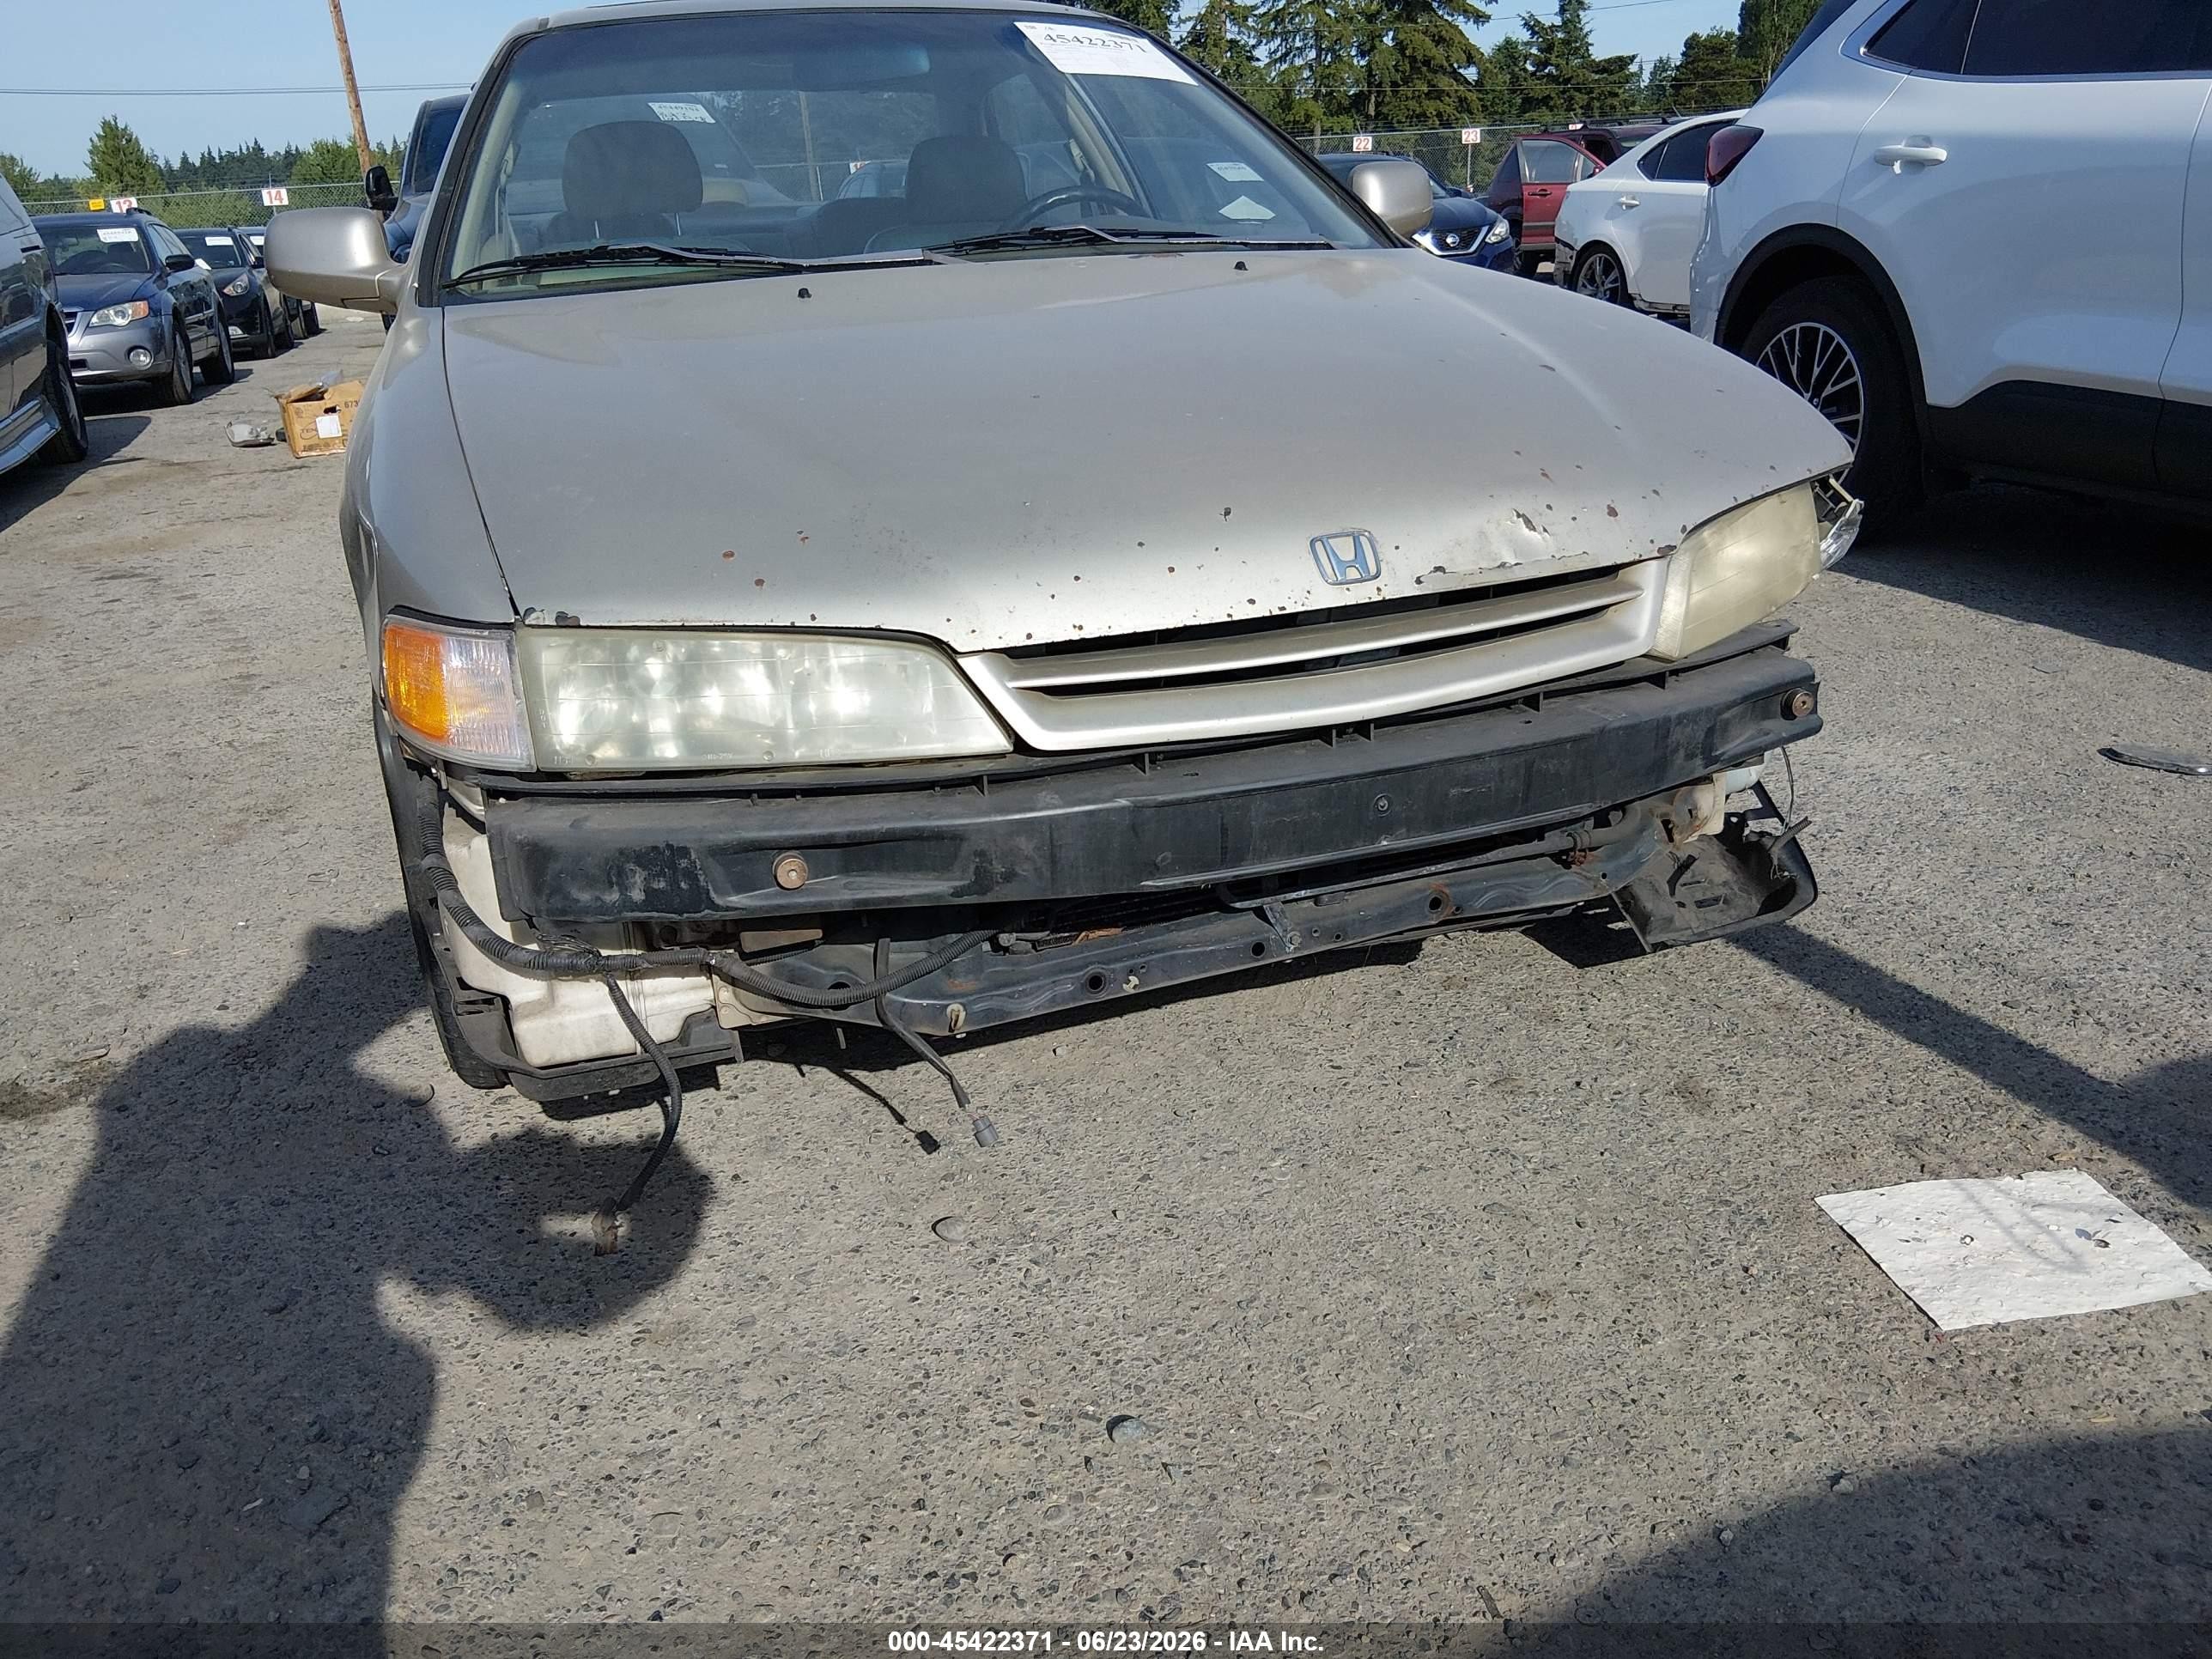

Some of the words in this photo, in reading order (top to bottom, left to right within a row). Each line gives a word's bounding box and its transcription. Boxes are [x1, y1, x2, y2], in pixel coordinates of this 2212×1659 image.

[1044, 33, 1147, 53] 45422371
[1355, 138, 1370, 150] 22
[1463, 131, 1478, 143] 23
[266, 189, 284, 205] 14
